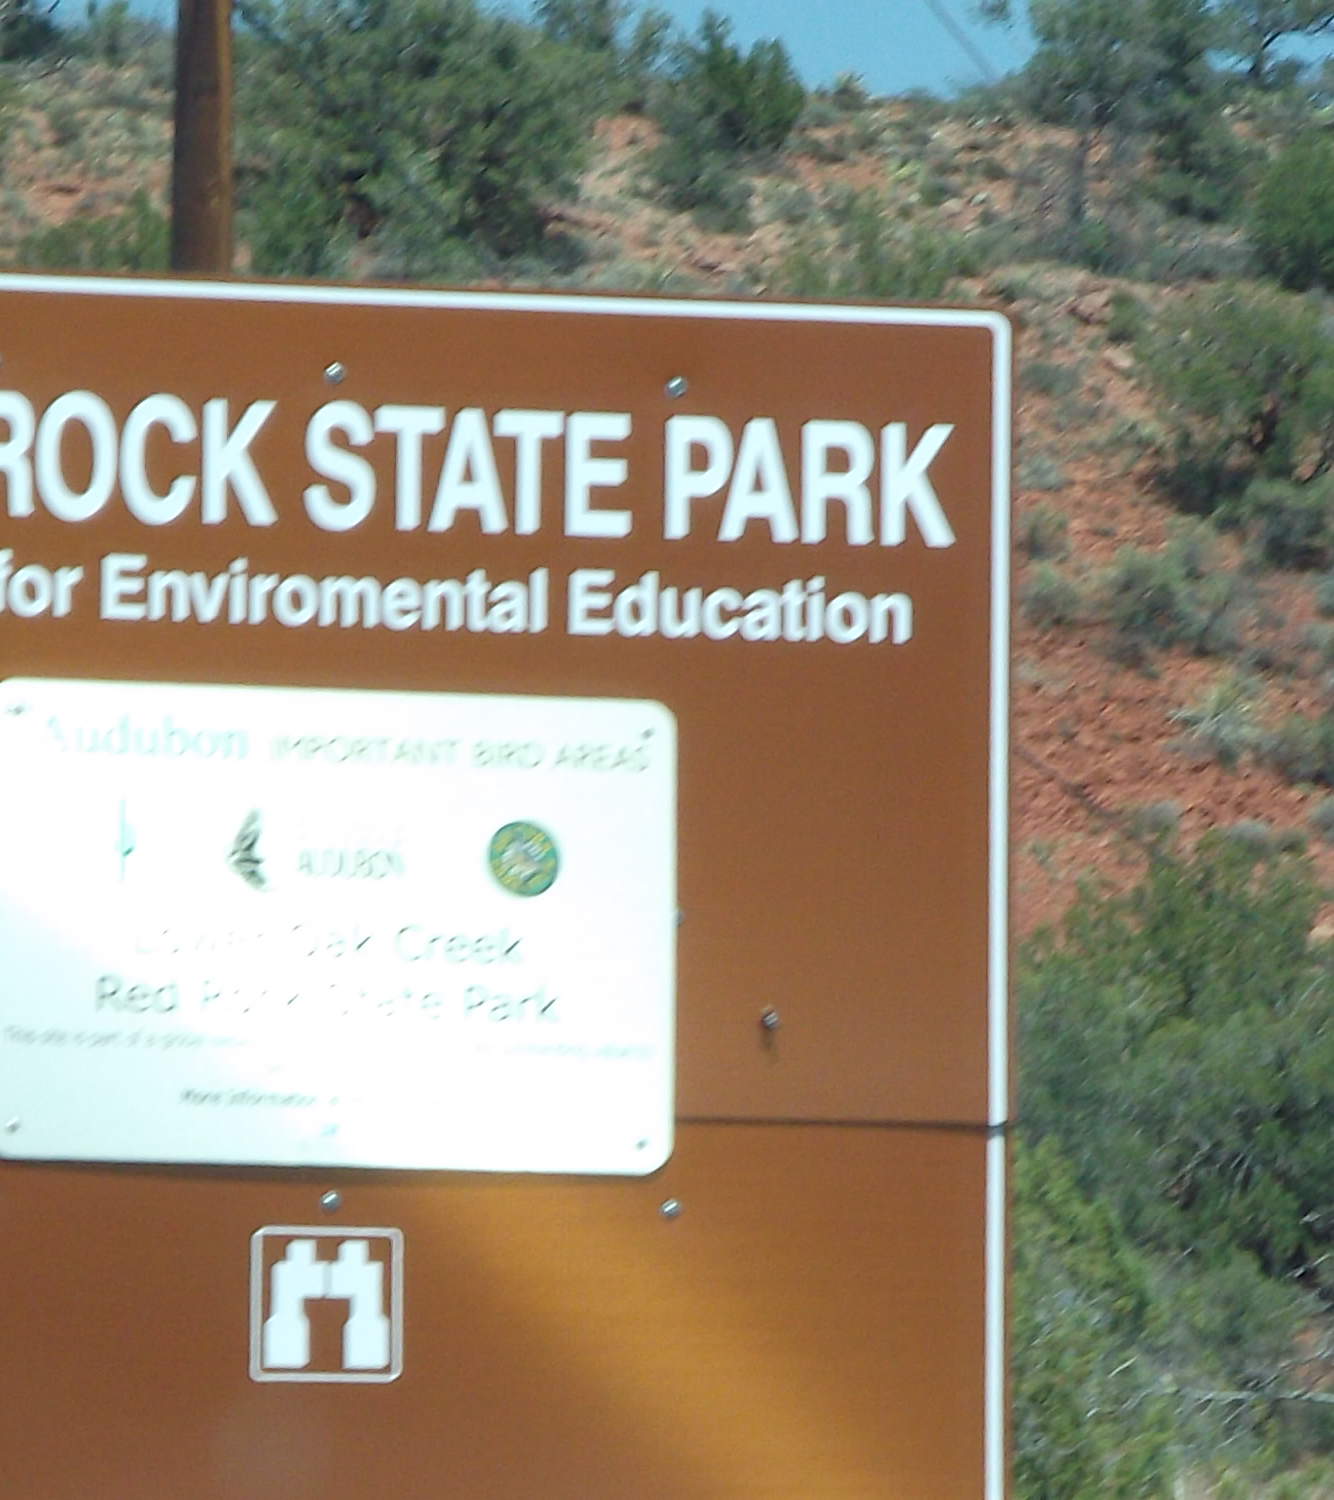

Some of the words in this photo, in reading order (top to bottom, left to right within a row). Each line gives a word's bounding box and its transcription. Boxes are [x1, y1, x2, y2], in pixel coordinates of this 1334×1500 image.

[303, 400, 632, 539] STATE
[665, 414, 956, 549] PARK
[100, 553, 549, 634] Enviromental
[568, 569, 913, 645] Education
[394, 923, 524, 965] Creek
[96, 974, 179, 1014] Red
[464, 983, 559, 1024] Park
